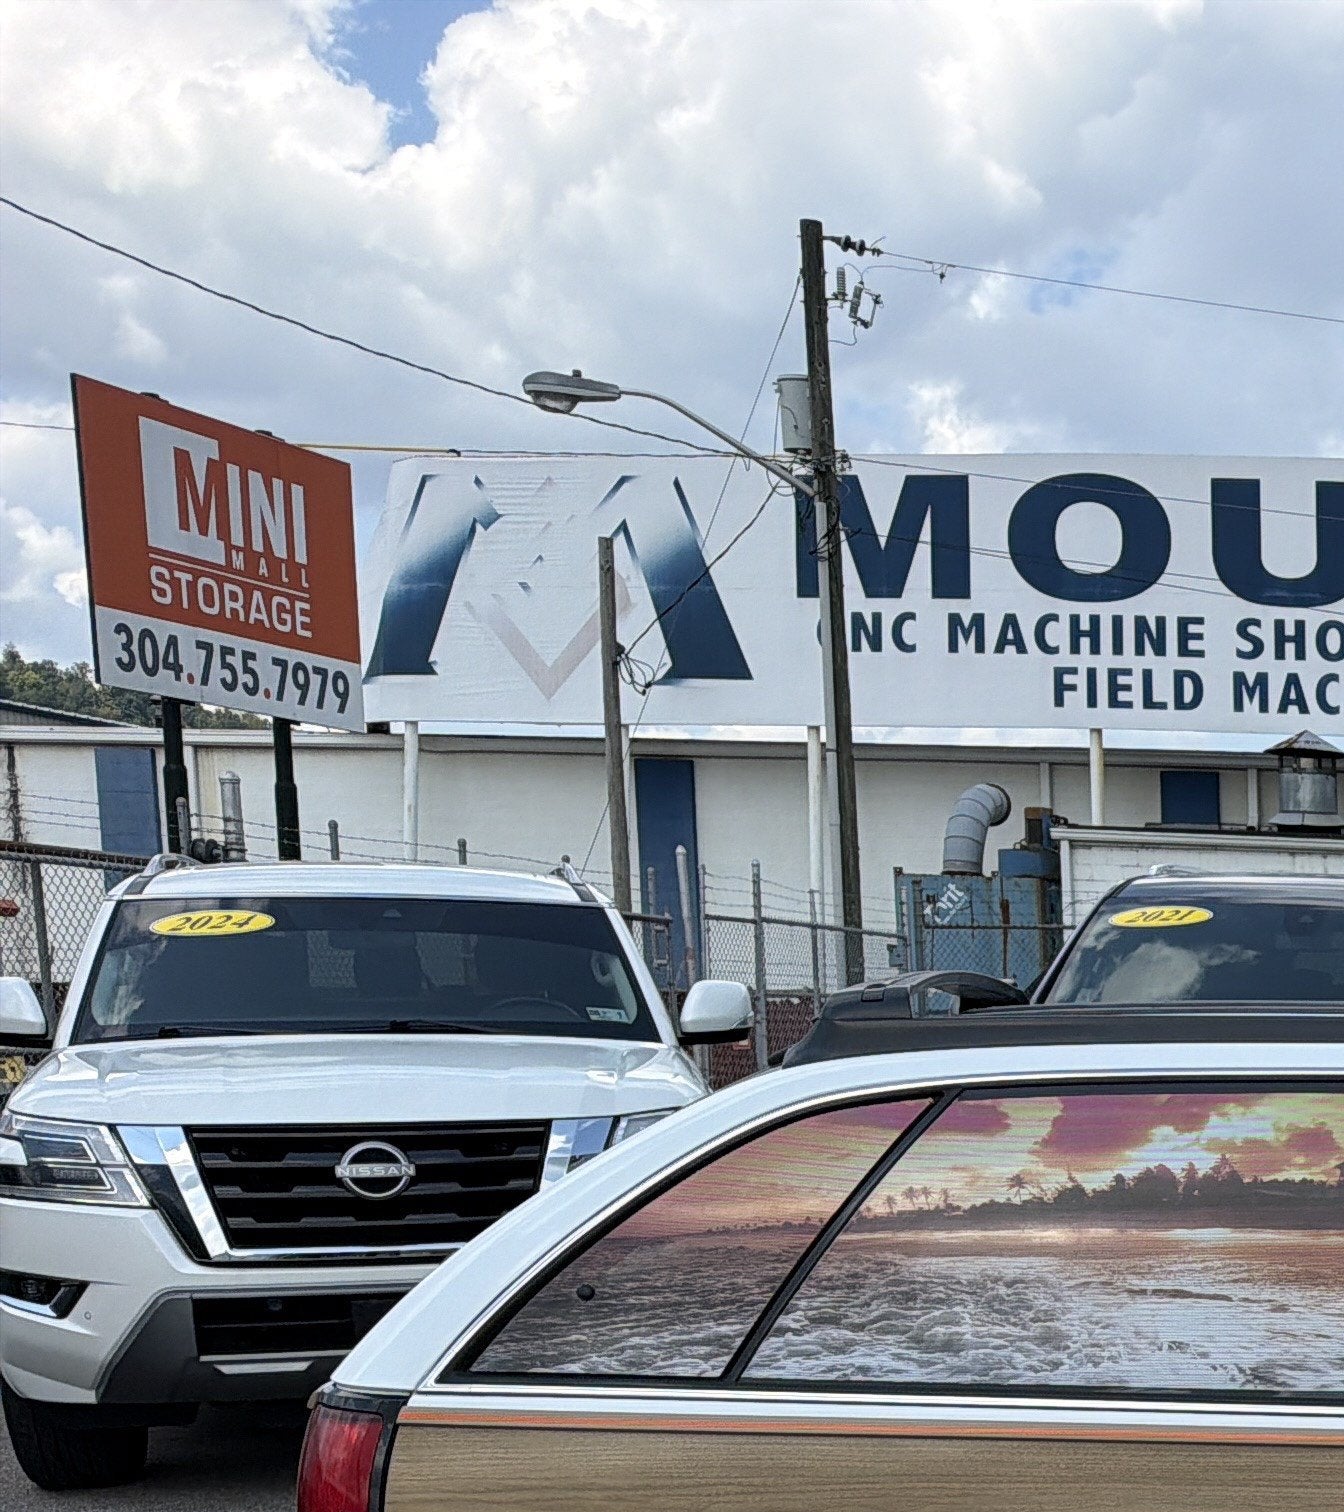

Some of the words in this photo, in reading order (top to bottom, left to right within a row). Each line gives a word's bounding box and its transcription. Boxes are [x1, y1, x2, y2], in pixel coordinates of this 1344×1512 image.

[172, 445, 308, 566] MINI
[231, 549, 310, 589] MALL
[150, 564, 313, 639] STORAGE
[816, 611, 917, 653] NC
[947, 611, 1206, 659] MACHINE
[113, 621, 351, 715] 304.755.7979
[1053, 665, 1205, 712] FIELD
[167, 914, 258, 932] 2024
[1124, 909, 1197, 924] 2021
[336, 1164, 416, 1177] NISSAN
